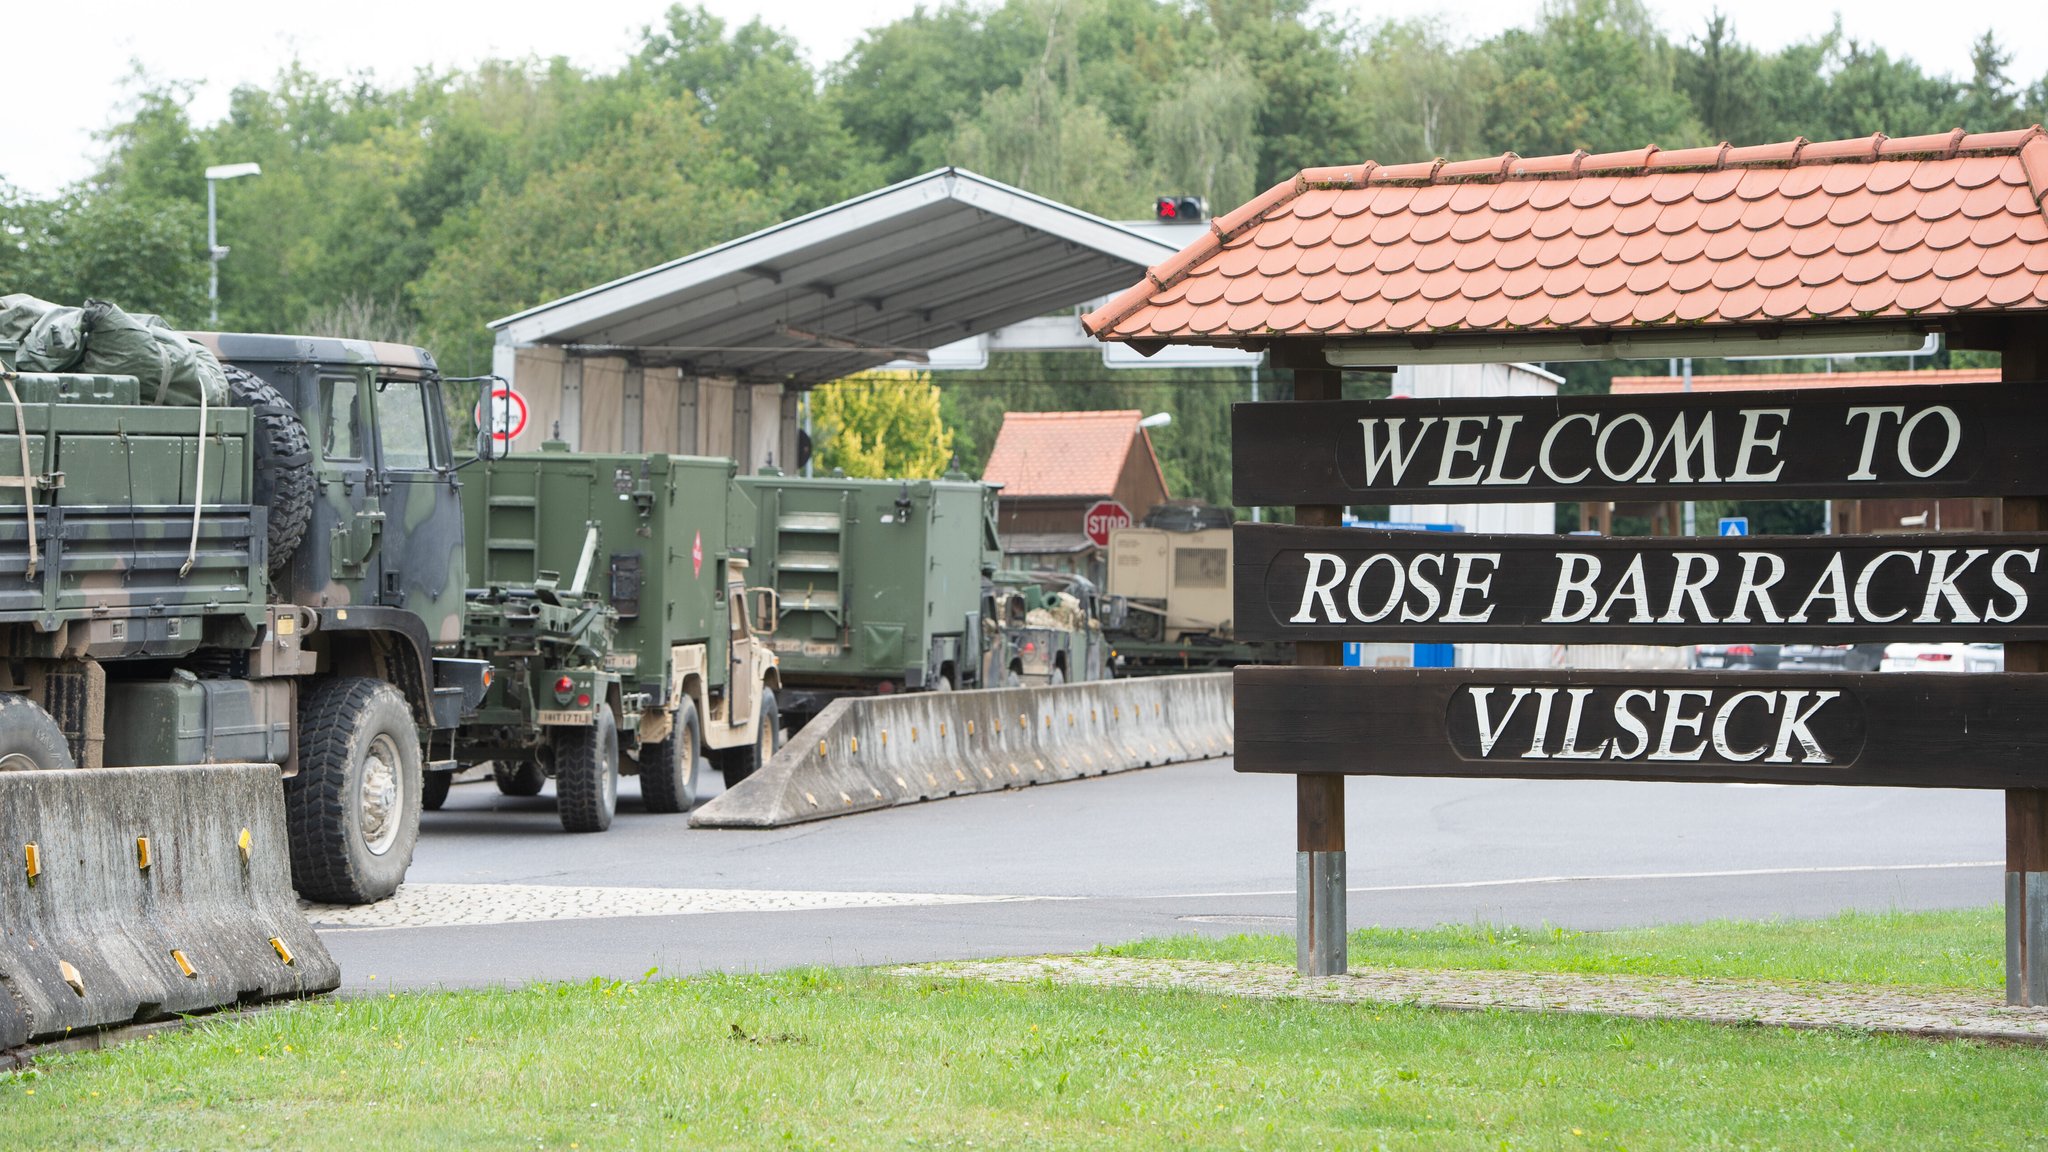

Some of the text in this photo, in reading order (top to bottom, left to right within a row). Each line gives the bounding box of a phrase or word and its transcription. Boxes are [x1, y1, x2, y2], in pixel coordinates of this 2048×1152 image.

[1357, 405, 1962, 488] WELCOME TO
[1088, 514, 1128, 535] STOP
[1289, 548, 2040, 624] ROSE BARRACKS
[1468, 686, 1841, 764] VILSECK
